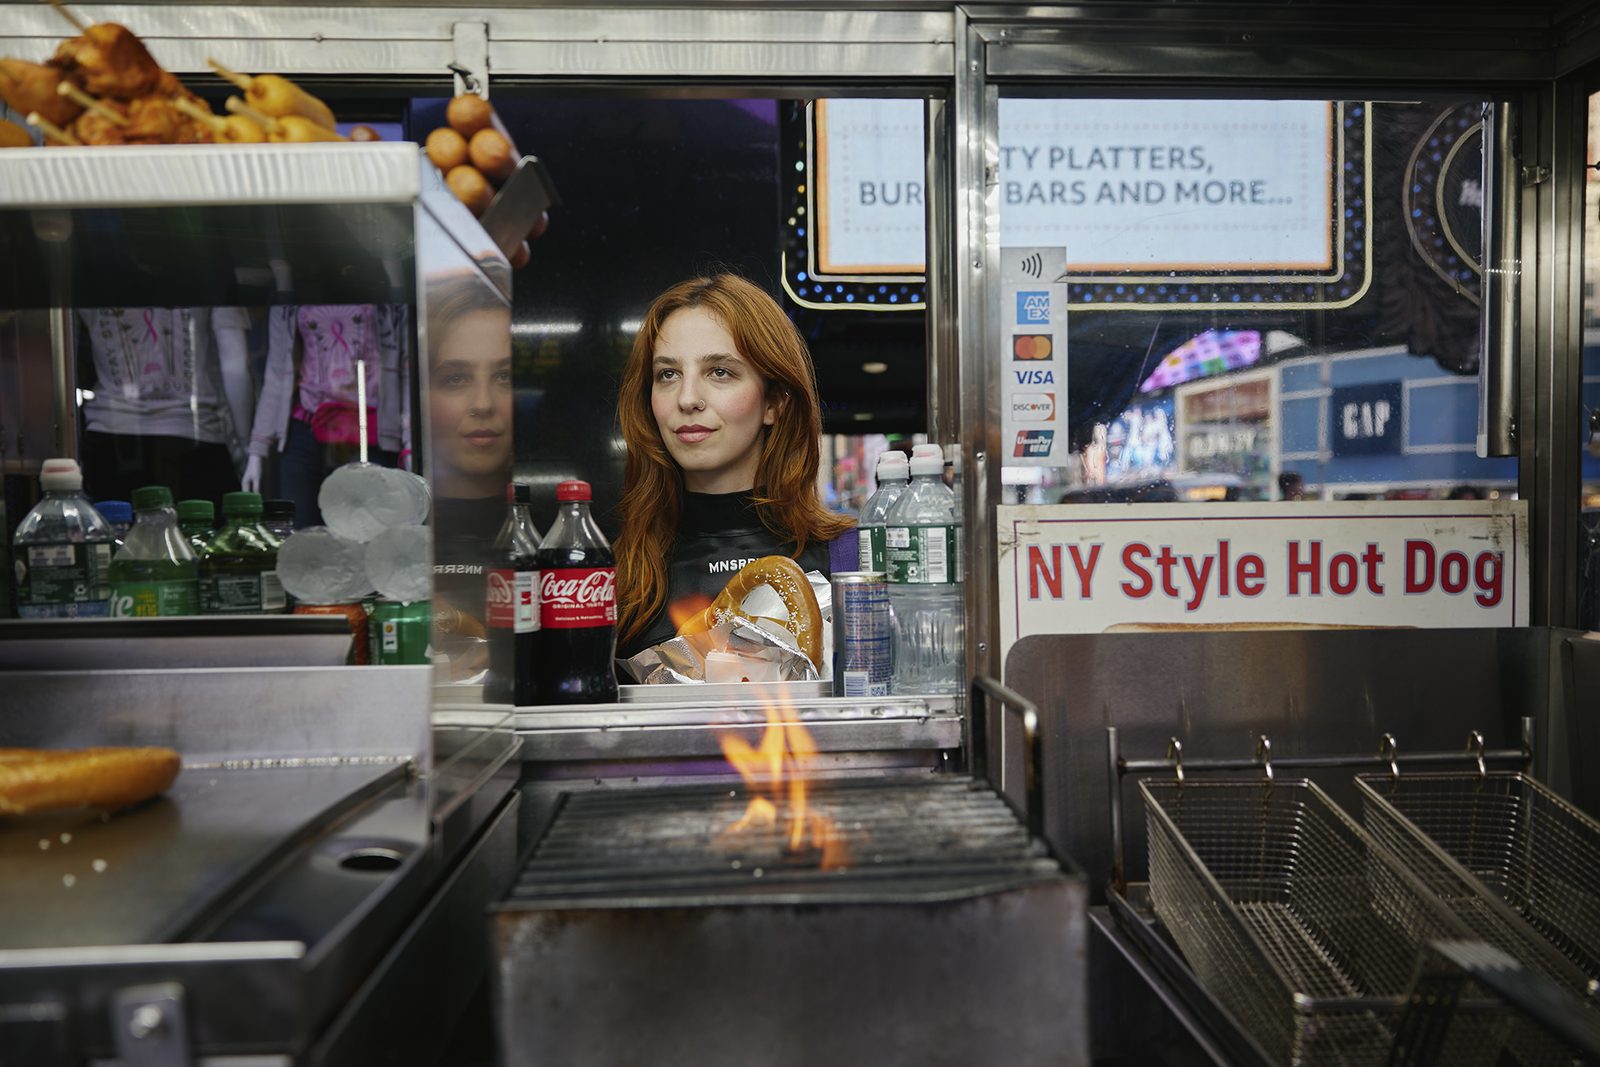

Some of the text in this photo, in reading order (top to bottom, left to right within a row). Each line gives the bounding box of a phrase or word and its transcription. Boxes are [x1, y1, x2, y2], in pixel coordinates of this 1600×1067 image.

[1049, 146, 1213, 174] PLATTERS,
[860, 180, 1292, 206] BUR BARS AND MORE...
[1013, 370, 1054, 384] VISA
[1343, 401, 1390, 438] GAP
[709, 558, 758, 573] MNSR
[1026, 538, 1505, 613] NY Style Hot Dog
